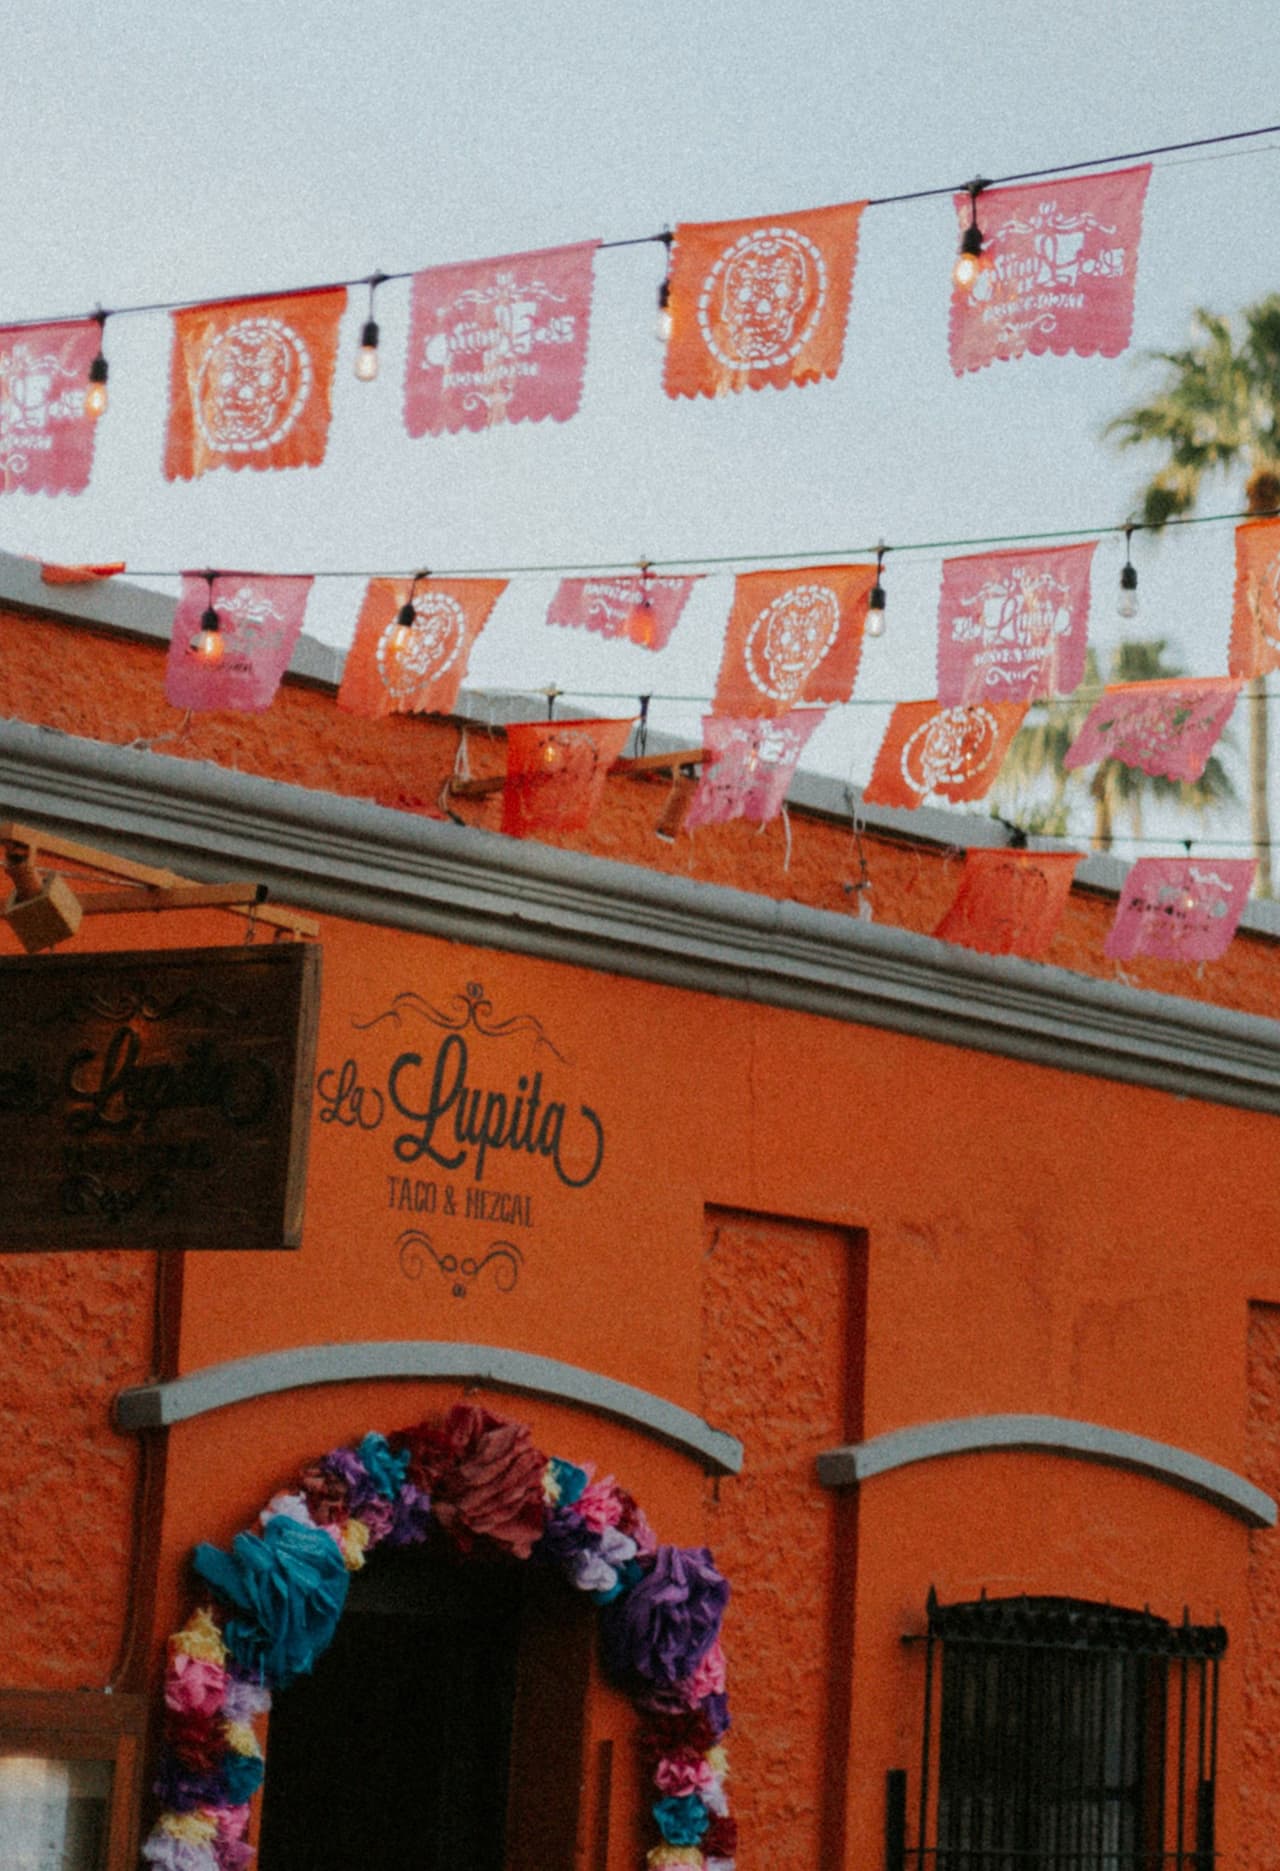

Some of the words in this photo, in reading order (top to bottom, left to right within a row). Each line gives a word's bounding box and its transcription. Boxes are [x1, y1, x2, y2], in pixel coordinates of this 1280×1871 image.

[317, 1059, 384, 1130] La
[388, 1034, 604, 1188] Lupita
[387, 1175, 437, 1214] TACO
[443, 1185, 456, 1216] &
[465, 1187, 534, 1227] MEZCAL
